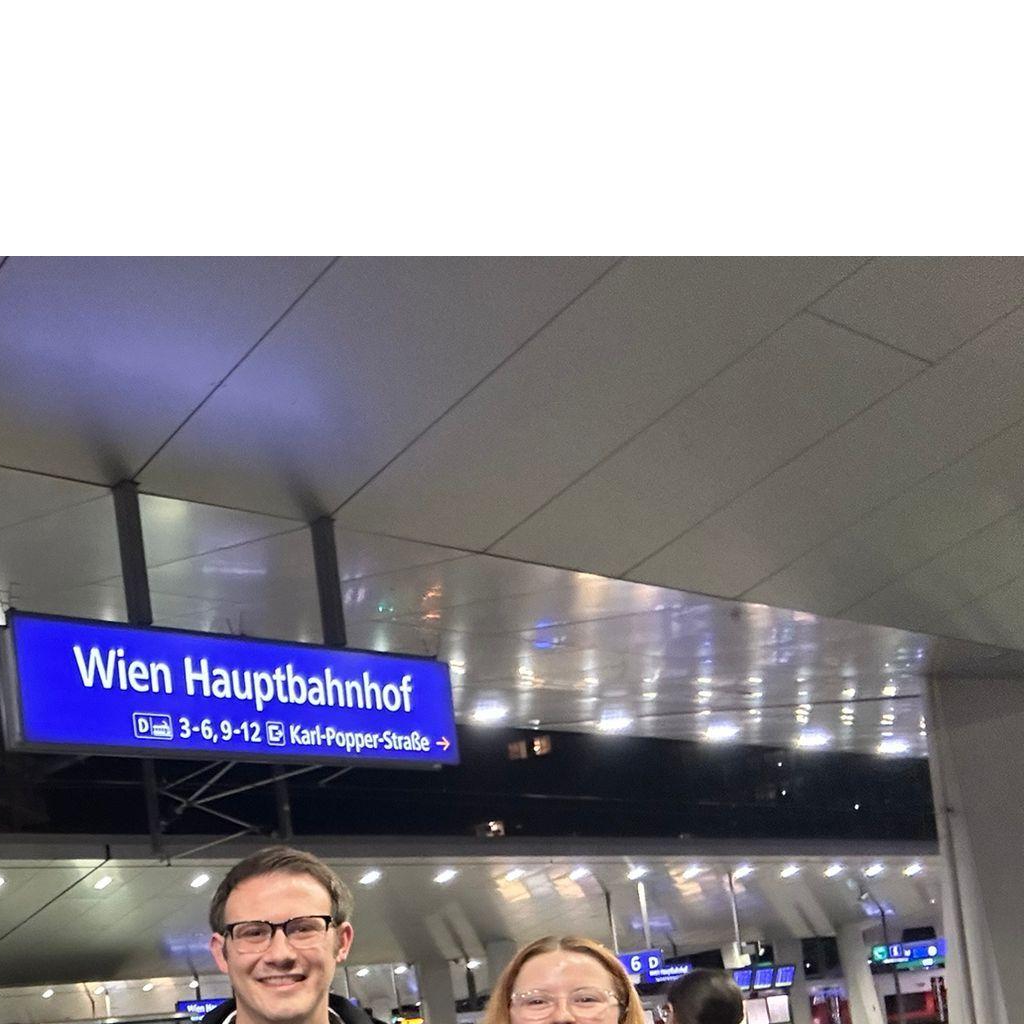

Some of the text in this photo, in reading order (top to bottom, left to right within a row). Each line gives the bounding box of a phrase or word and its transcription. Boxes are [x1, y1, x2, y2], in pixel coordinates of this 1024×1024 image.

[73, 645, 413, 713] Wien Hauptbahnhof
[289, 724, 430, 752] Karl-Popper-Straße
[630, 955, 642, 972] 6
[648, 956, 659, 970] D
